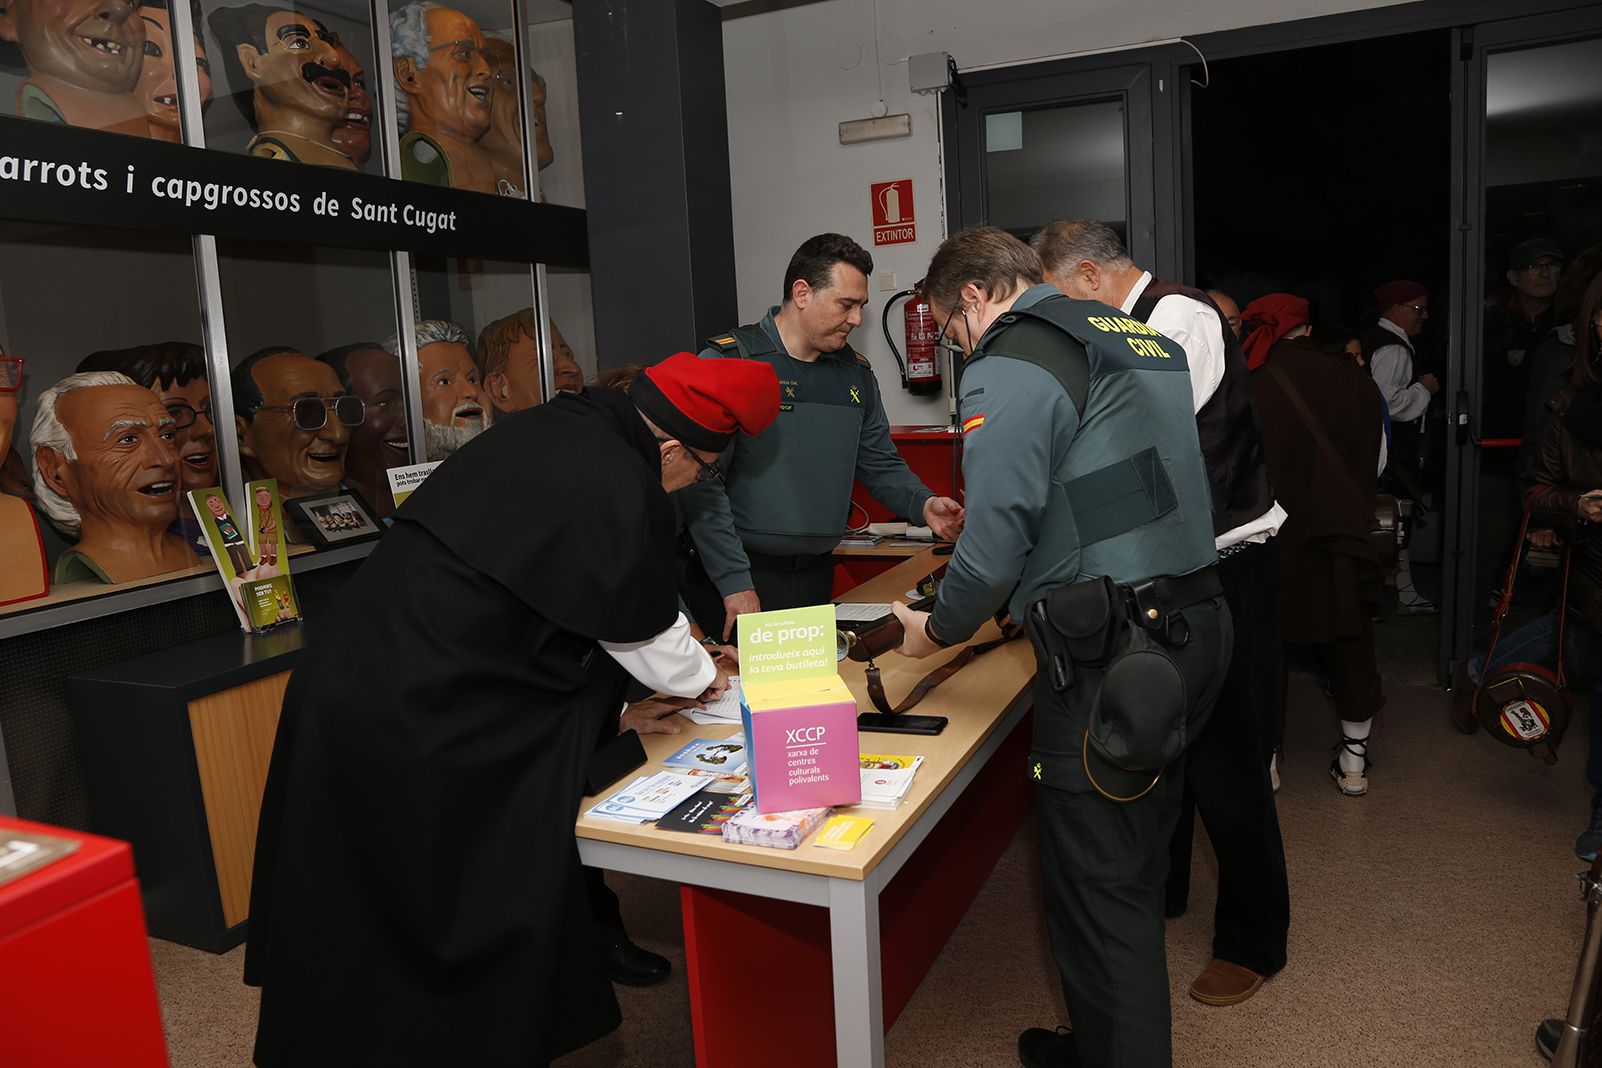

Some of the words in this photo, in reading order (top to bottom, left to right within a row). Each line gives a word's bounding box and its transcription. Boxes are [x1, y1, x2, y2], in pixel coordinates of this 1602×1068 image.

[127, 165, 134, 193] i
[152, 177, 300, 212] capgrossos
[314, 192, 338, 216] de
[351, 198, 397, 223] Sant
[404, 205, 455, 233] Cugat
[876, 228, 914, 242] EXTINTOR
[1126, 337, 1171, 358] CIVIL
[405, 471, 418, 479] hem
[750, 627, 773, 643] de
[778, 625, 824, 645] prop:
[749, 649, 801, 662] introdueix
[749, 665, 759, 674] la
[761, 662, 784, 673] teva
[785, 726, 826, 743] XCCP
[787, 750, 808, 758] xarxa
[809, 747, 819, 756] de
[787, 758, 816, 767] centres
[788, 767, 821, 776] culturals
[789, 775, 829, 787] polivalents
